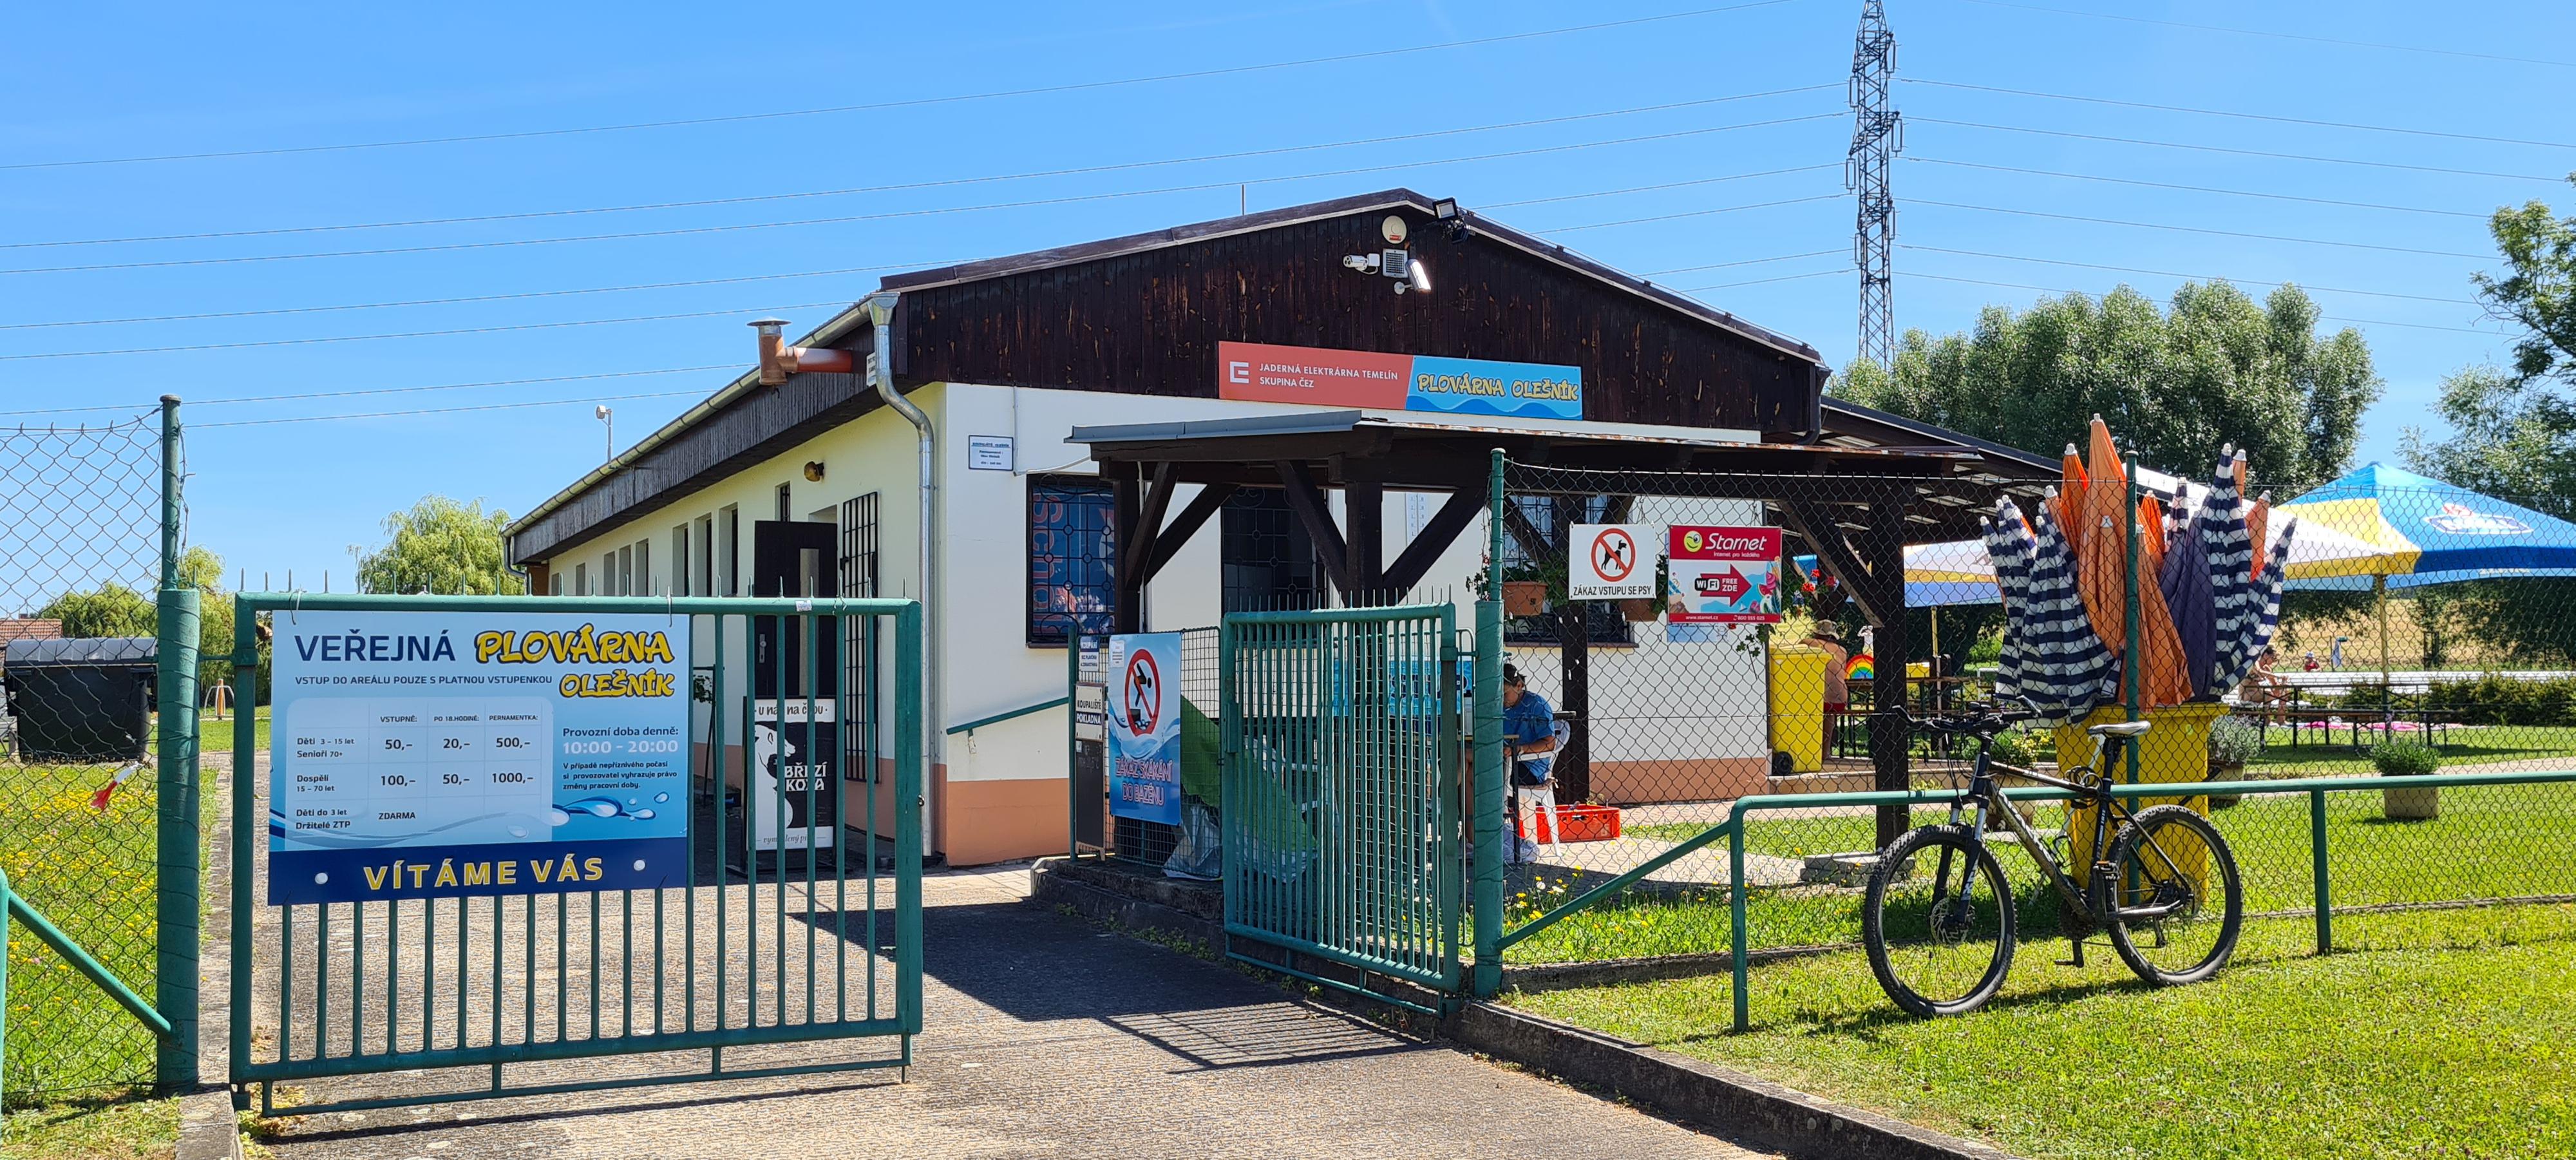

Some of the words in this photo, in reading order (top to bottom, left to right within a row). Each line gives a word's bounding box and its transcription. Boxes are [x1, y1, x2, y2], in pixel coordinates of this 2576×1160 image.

[1260, 363, 1301, 374] JADERNÁ
[1304, 366, 1359, 378] ELEKTRÁRNA
[1362, 369, 1398, 380] TEMELÍN
[1260, 376, 1297, 387] SKUPINA
[1299, 377, 1314, 388] ČEZ
[1417, 372, 1506, 397] PLOVÁRNA
[1511, 378, 1579, 401] OLEŠNÍK
[1705, 533, 1767, 551] Starnet
[1573, 584, 1597, 596] ZÁKAZ
[1598, 585, 1627, 595] VSTUPU
[1627, 585, 1636, 594] SE
[1638, 585, 1652, 594] PSY
[294, 629, 456, 661] VEŘEJNÁ
[474, 623, 675, 664] PLOVÁRNA
[295, 676, 330, 685] VSTUP
[333, 676, 348, 685] DO
[350, 674, 390, 684] AREÁLU
[439, 676, 484, 684] PLATNOU
[488, 676, 553, 684] VSTUPENKOU
[559, 667, 675, 698] OLEŠNÍK
[786, 705, 800, 715] na
[802, 702, 824, 714] ču
[1077, 699, 1101, 710] KOUPALIŠTĚ
[1076, 712, 1101, 725] POKLADNA
[563, 727, 611, 737] Provozní
[613, 726, 639, 736] doba
[642, 725, 679, 736] denně:
[563, 741, 612, 754] 10:00
[627, 739, 679, 753] 20:00
[570, 761, 598, 770] případě
[599, 761, 644, 770] nepříznivého
[645, 760, 668, 768] počasí
[784, 761, 827, 777] BŘZÍ
[1115, 756, 1139, 778] ZÁKAZ
[1139, 758, 1173, 782] SKÁKÁNÍ
[297, 775, 329, 784] Dospělí
[573, 772, 619, 781] provozovatel
[621, 771, 656, 779] vyhrazuje
[563, 782, 588, 790] změny
[589, 781, 620, 790] pracovní
[785, 777, 825, 792] KOA
[1122, 782, 1134, 801] DO
[1134, 782, 1165, 806] BAZÉNU
[379, 812, 416, 821] ZDARMA
[332, 821, 351, 829] ZTP
[363, 858, 517, 891] VÍTÁME
[530, 853, 603, 883] VÁS
